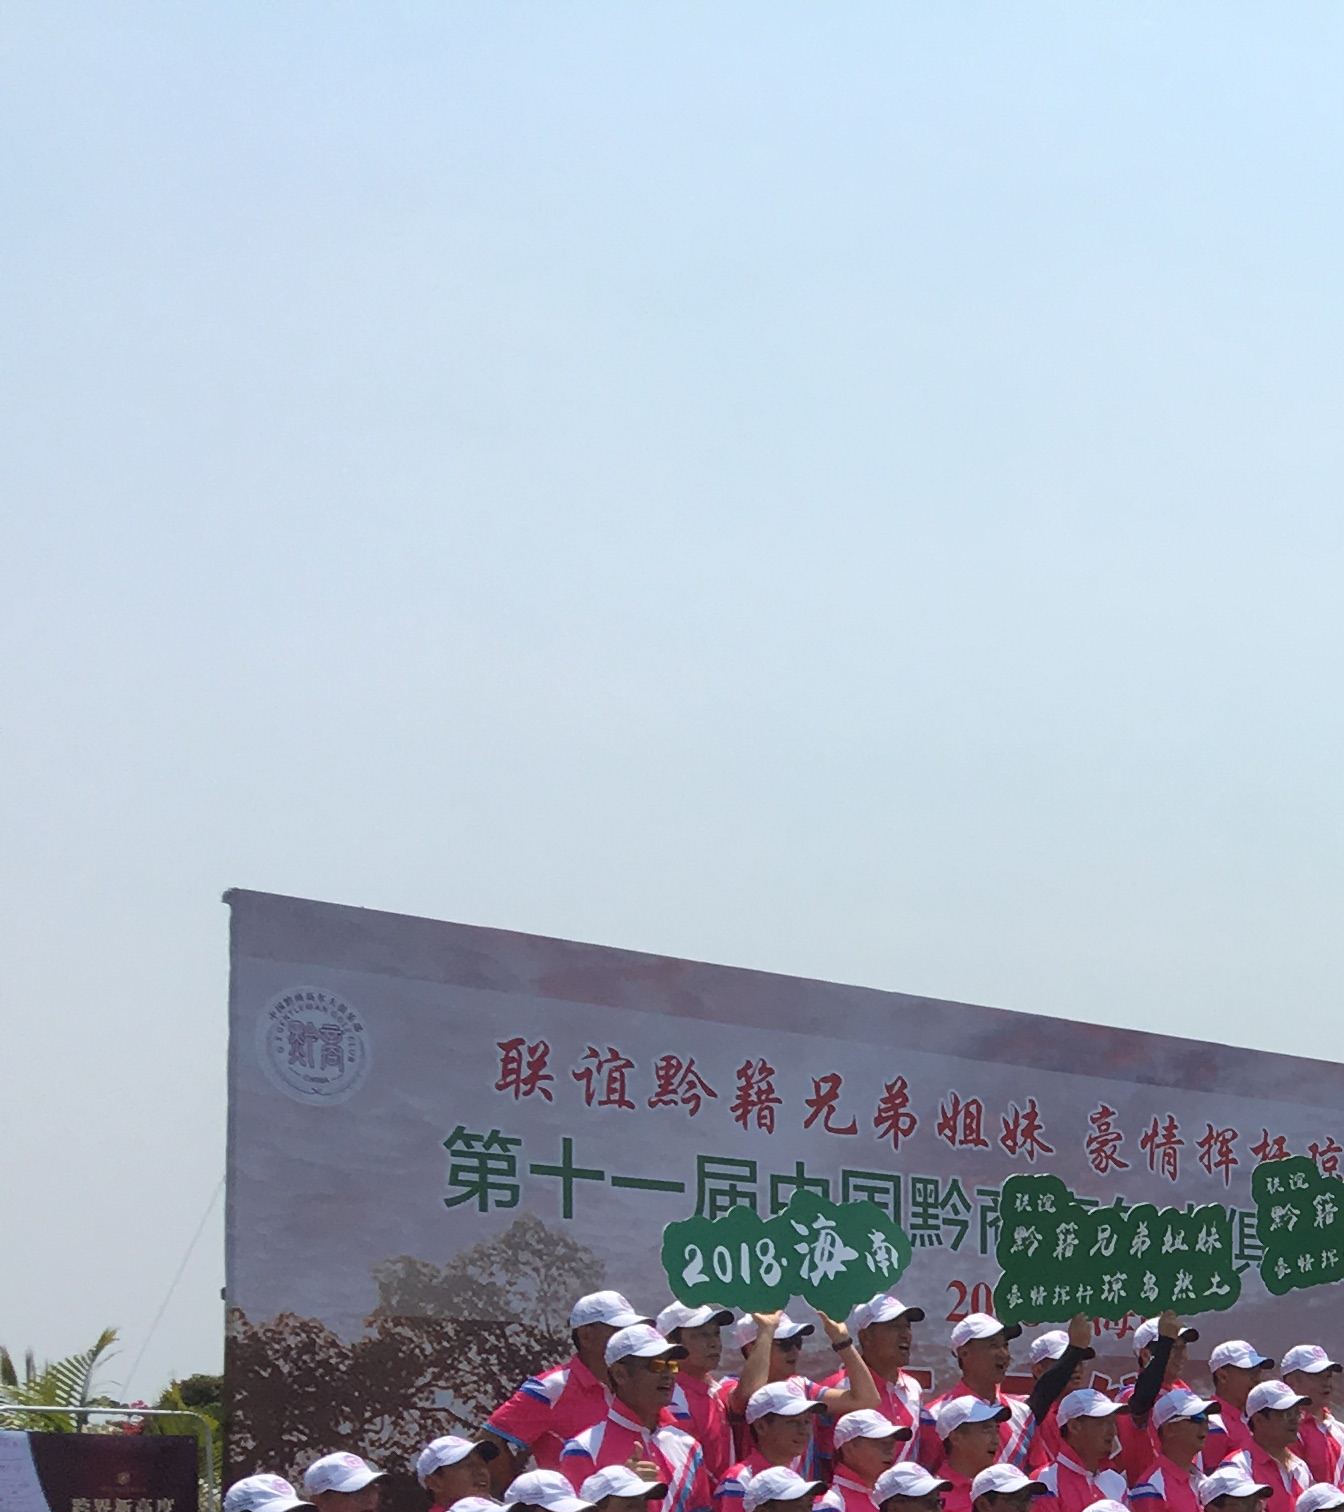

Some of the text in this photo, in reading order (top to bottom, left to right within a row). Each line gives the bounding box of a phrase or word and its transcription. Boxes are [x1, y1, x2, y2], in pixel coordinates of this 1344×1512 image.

[496, 1037, 1055, 1160] 联谊黔籍兄弟姐妹
[1009, 1221, 1224, 1261] 黔籍兄弟姐妹
